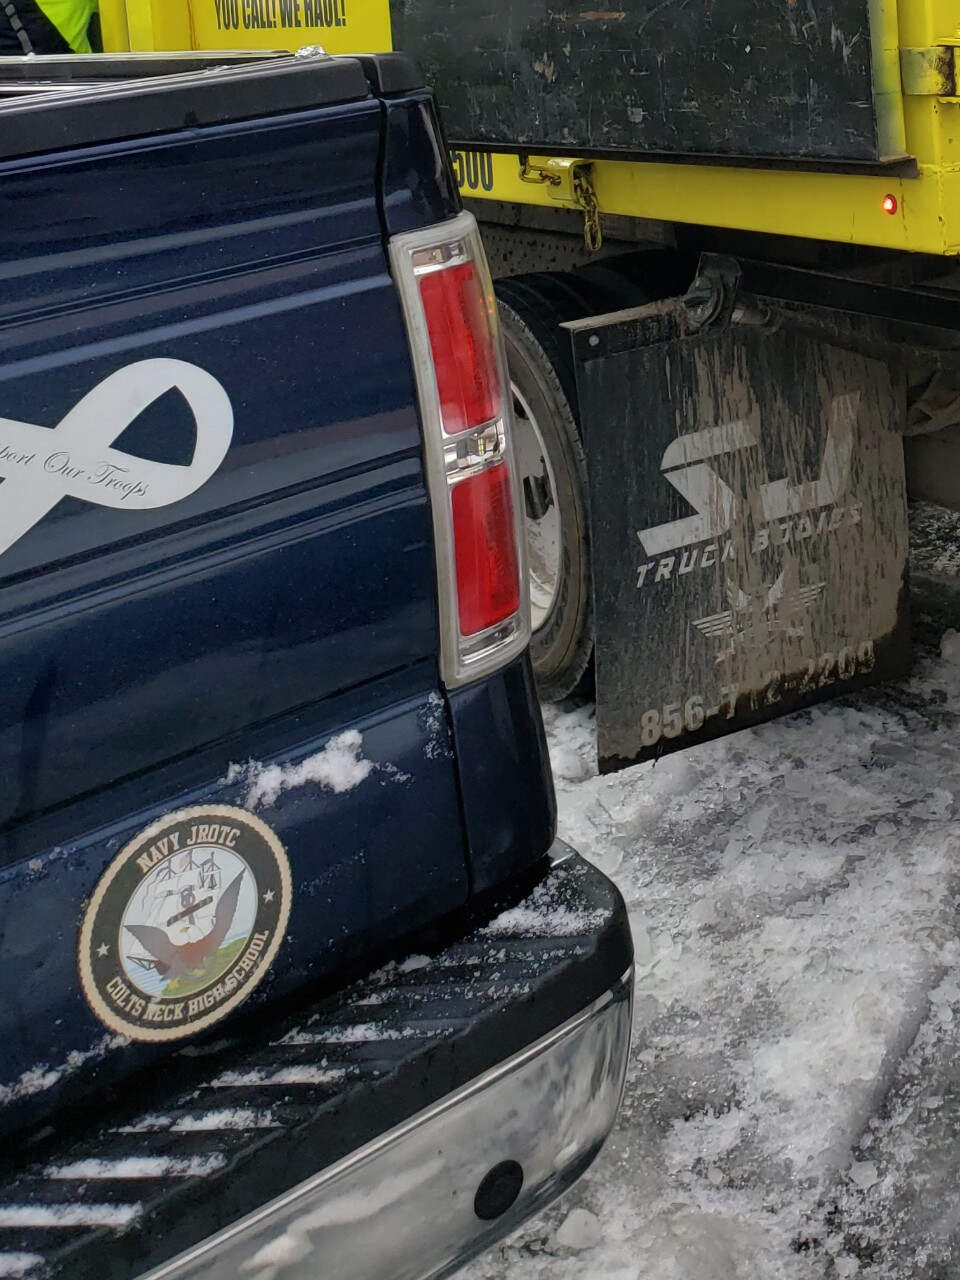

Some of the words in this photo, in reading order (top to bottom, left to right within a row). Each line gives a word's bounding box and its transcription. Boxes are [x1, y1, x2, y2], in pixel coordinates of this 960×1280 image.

[44, 451, 86, 479] Our
[87, 460, 150, 501] Troops
[136, 832, 179, 873] NAVY
[187, 824, 241, 848] JROTC
[106, 976, 146, 1016] COLTS
[143, 1002, 185, 1021] NECK
[188, 982, 226, 1017] HIGH
[225, 930, 269, 991] SCHOOL
